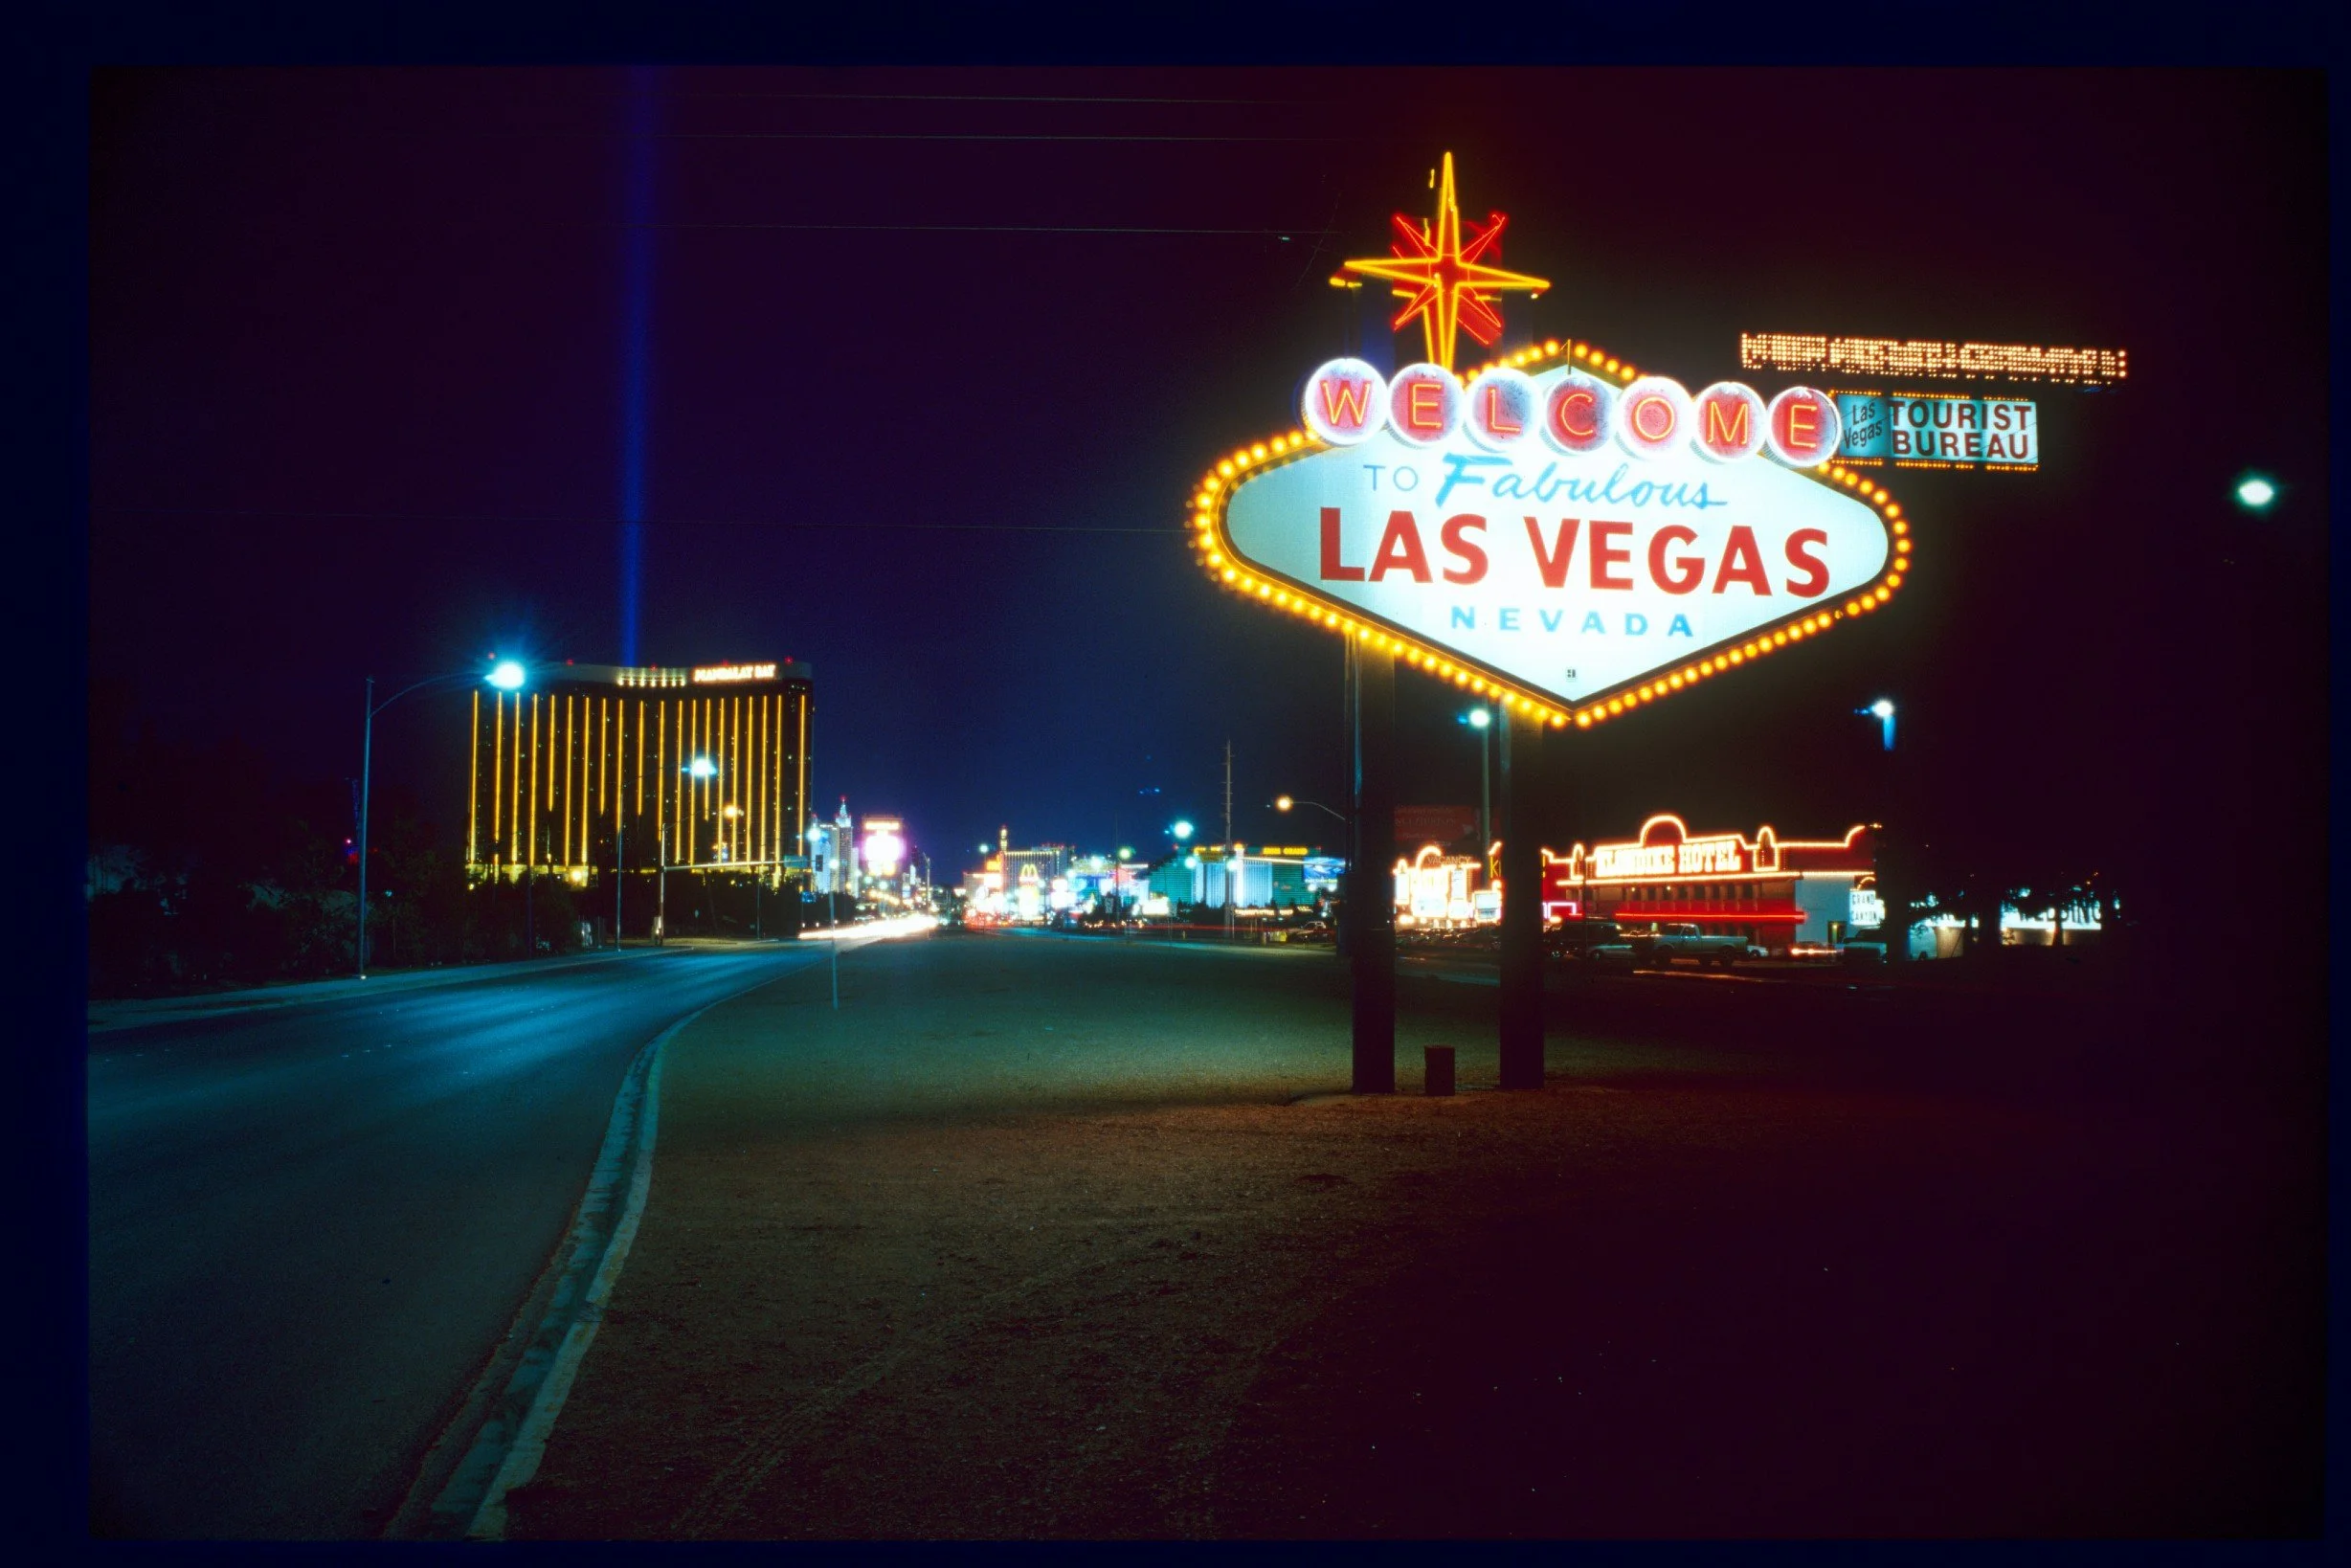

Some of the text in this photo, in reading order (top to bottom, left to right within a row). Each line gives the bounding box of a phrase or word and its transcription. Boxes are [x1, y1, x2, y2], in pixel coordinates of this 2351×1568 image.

[1319, 378, 1821, 449] WELCOME
[1851, 401, 1875, 426] Las
[1890, 400, 2032, 432] TOURIST
[1843, 420, 1884, 449] Vegas
[1892, 430, 2029, 459] BUREAU
[1363, 452, 1728, 510] TO Fabulous
[1320, 506, 1830, 599] LAS VEGAS
[1450, 605, 1694, 638] NEVADA
[1678, 840, 1741, 874] HOTEL
